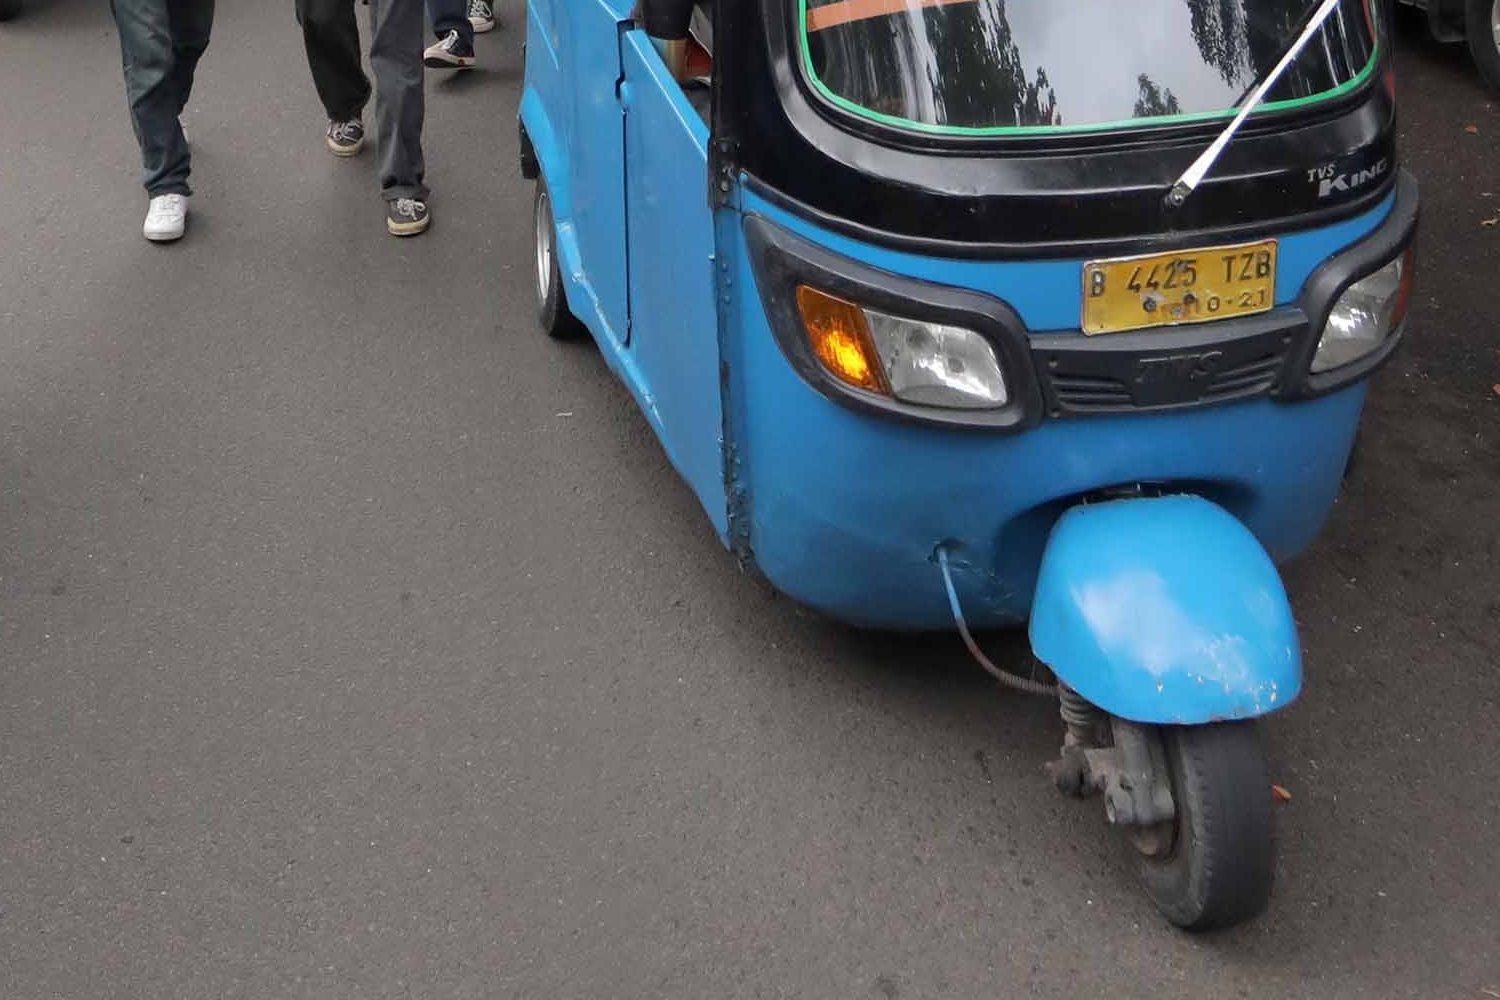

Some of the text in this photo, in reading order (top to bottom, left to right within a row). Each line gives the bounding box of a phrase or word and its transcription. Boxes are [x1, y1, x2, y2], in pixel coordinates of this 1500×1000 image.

[1307, 162, 1337, 183] TVS
[1318, 158, 1388, 197] KING
[1090, 251, 1271, 297] B 4425 TZB
